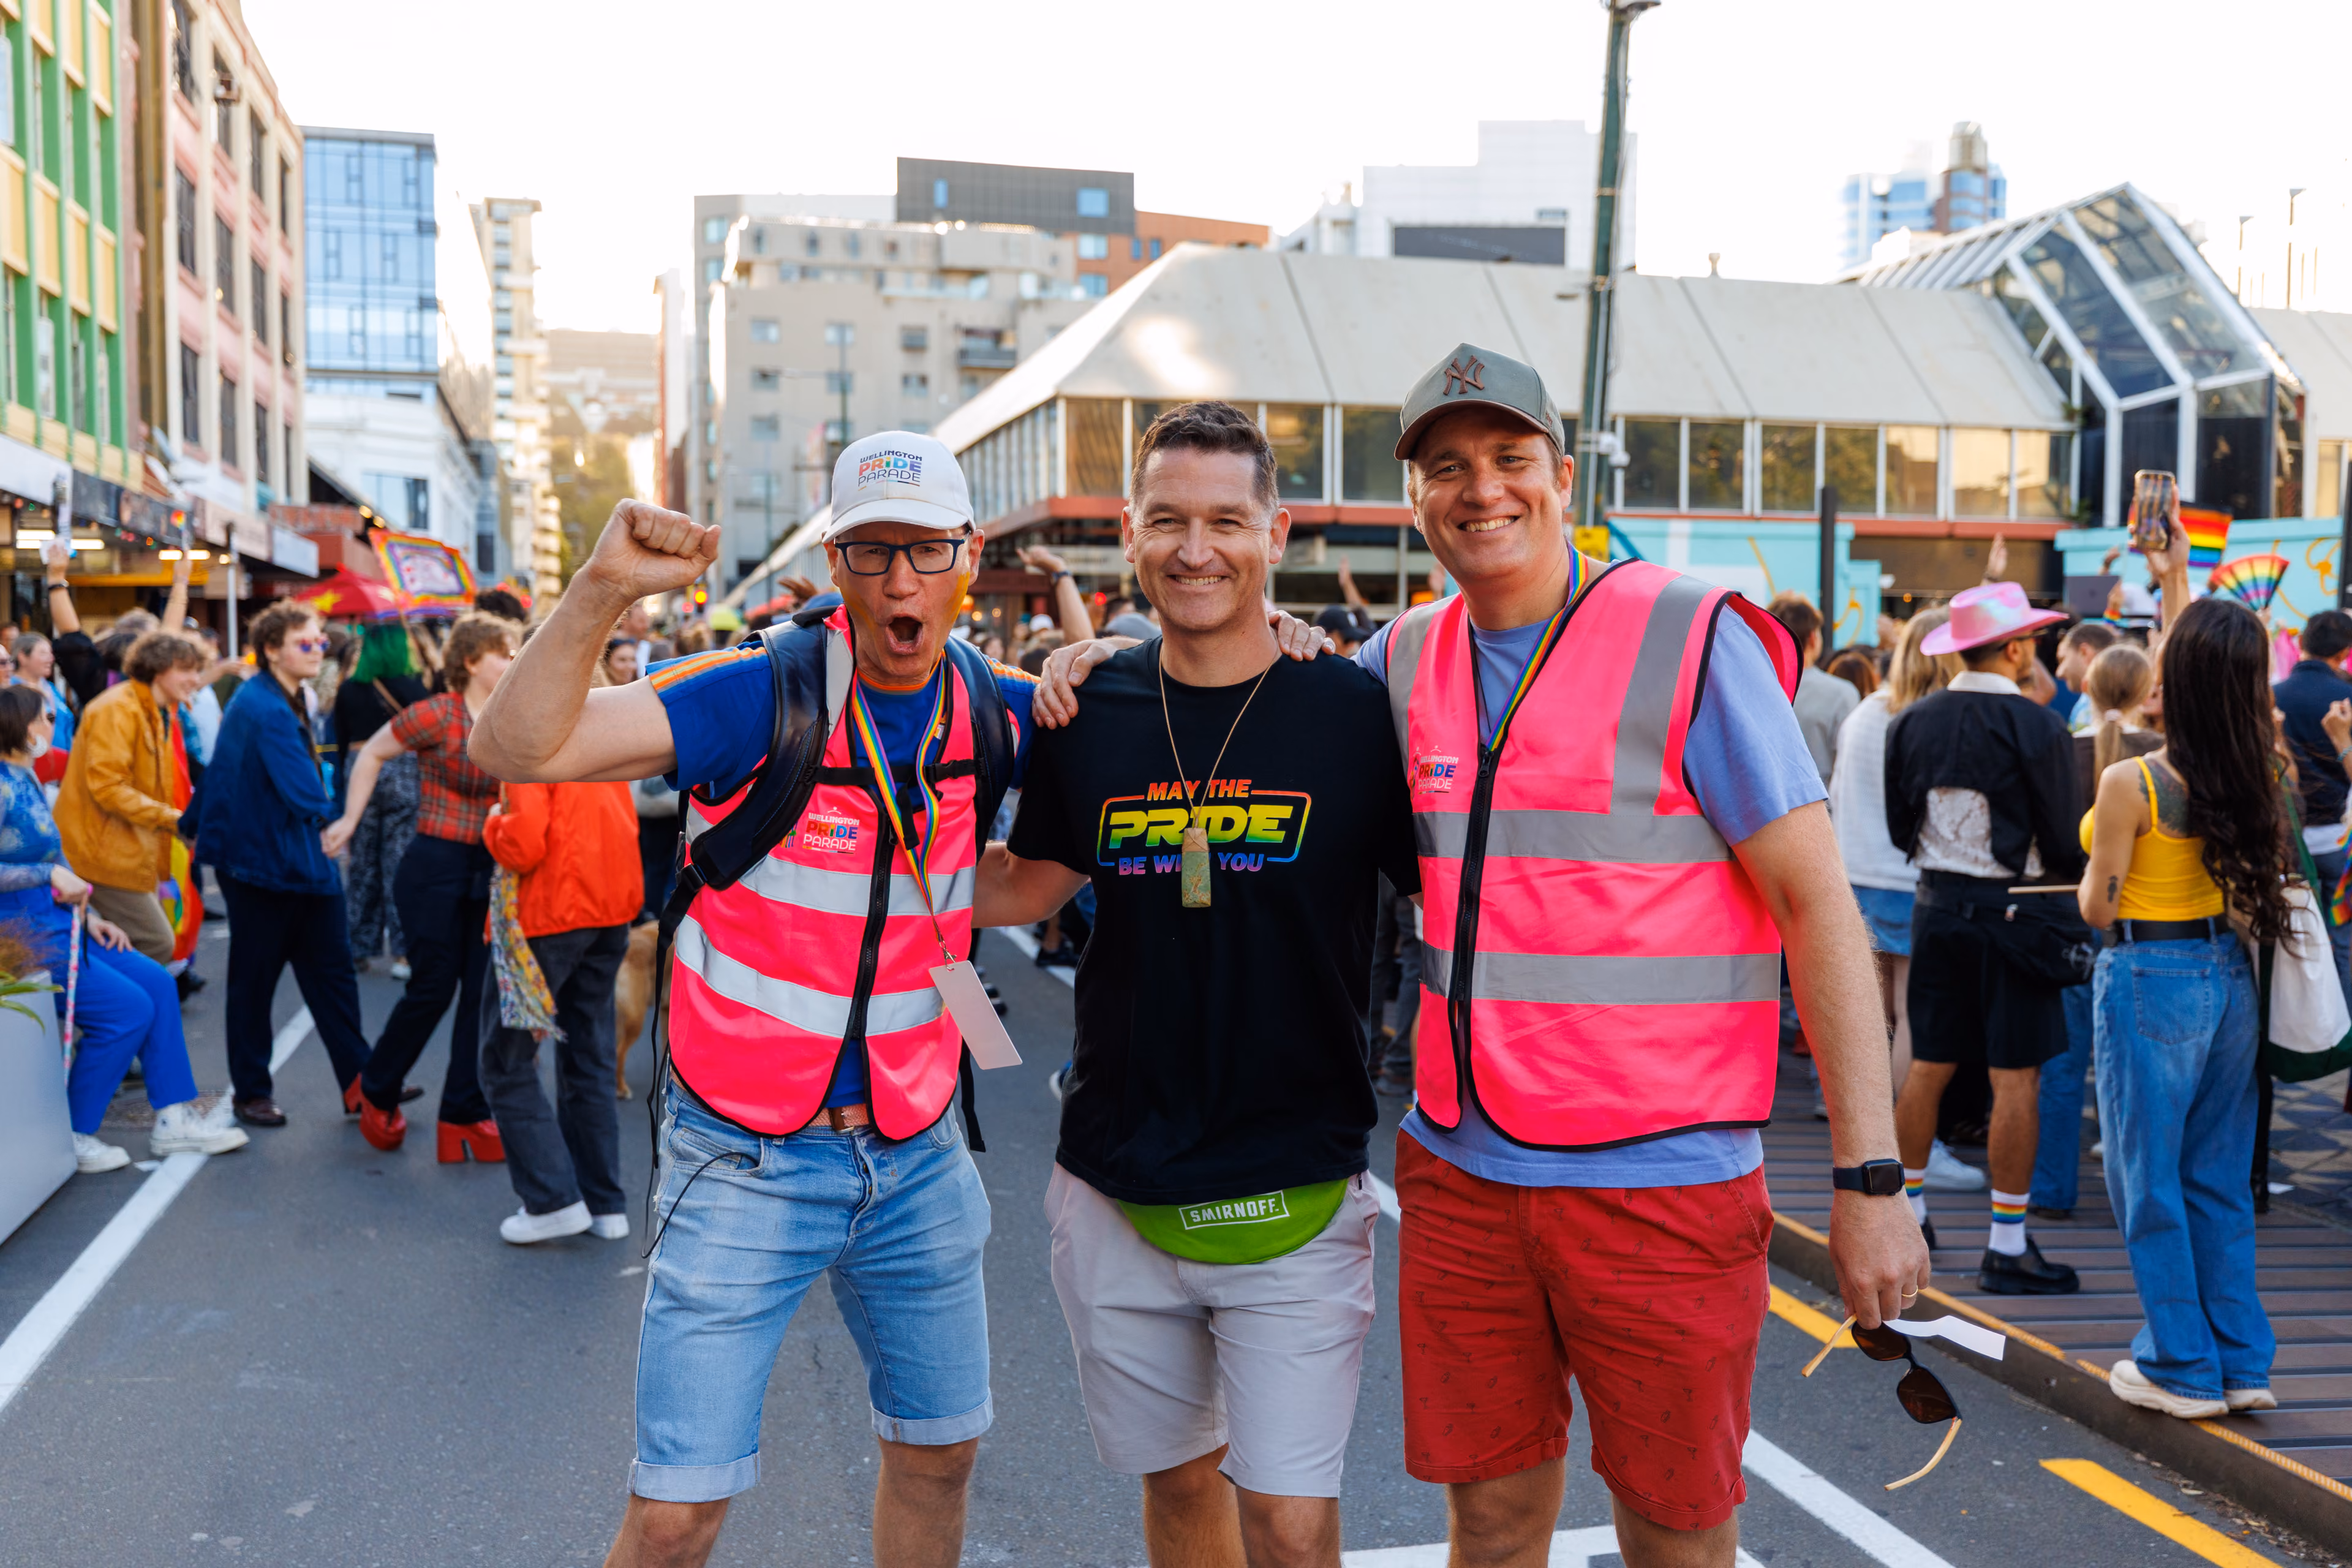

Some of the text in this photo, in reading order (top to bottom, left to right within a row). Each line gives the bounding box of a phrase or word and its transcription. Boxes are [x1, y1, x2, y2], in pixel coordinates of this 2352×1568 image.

[860, 450, 922, 463] WELLINGTON
[858, 469, 921, 487] PARADE
[1147, 779, 1252, 801] MAY THE
[1418, 778, 1453, 790] PARADE
[809, 812, 860, 826] WELLINGTON
[1109, 804, 1294, 849] PRIDE
[803, 834, 857, 851] PARADE
[1119, 856, 1147, 875] BE
[1217, 852, 1265, 872] YOU
